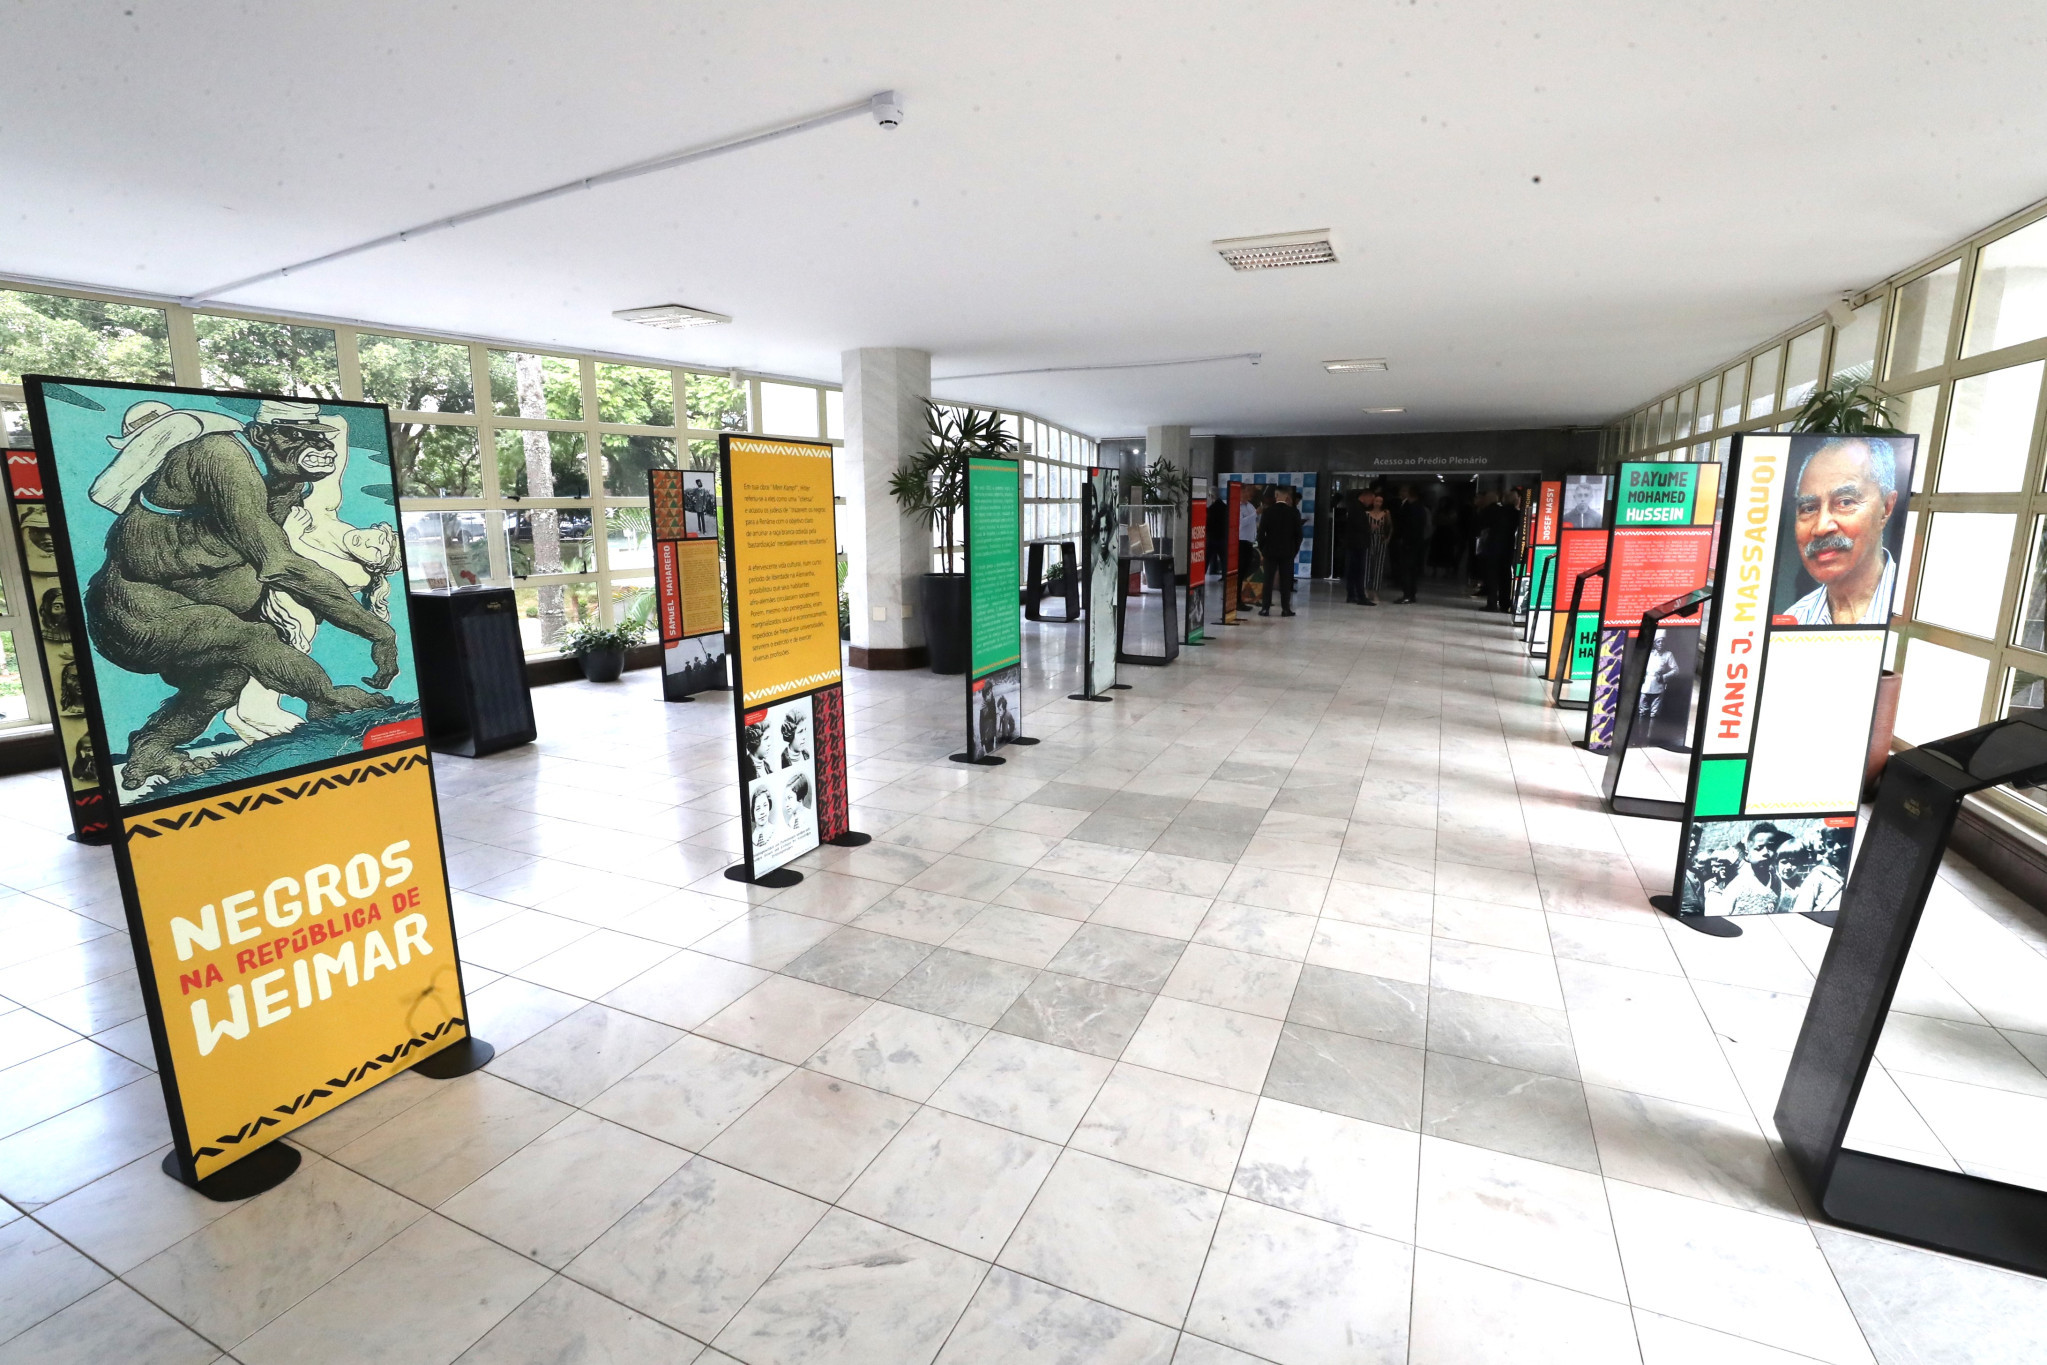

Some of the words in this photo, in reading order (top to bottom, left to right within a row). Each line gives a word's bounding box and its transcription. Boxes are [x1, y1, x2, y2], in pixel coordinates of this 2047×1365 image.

[1418, 456, 1447, 465] Prédio
[1449, 456, 1488, 464] Plenário
[1546, 488, 1555, 514] NASSY
[1628, 490, 1686, 504] MOHAMED
[1543, 516, 1552, 541] JOSEF
[1734, 456, 1777, 622] MASSAQUOI
[664, 545, 673, 596] MAHARERO
[668, 600, 676, 636] SAMUEL
[1731, 630, 1754, 654] J.
[1718, 664, 1748, 739] HANS
[170, 840, 413, 962] NEGROS
[180, 963, 224, 996] NA
[236, 902, 381, 974] REPÚBLICA
[392, 886, 421, 914] DE
[191, 913, 434, 1056] WEIMAR
